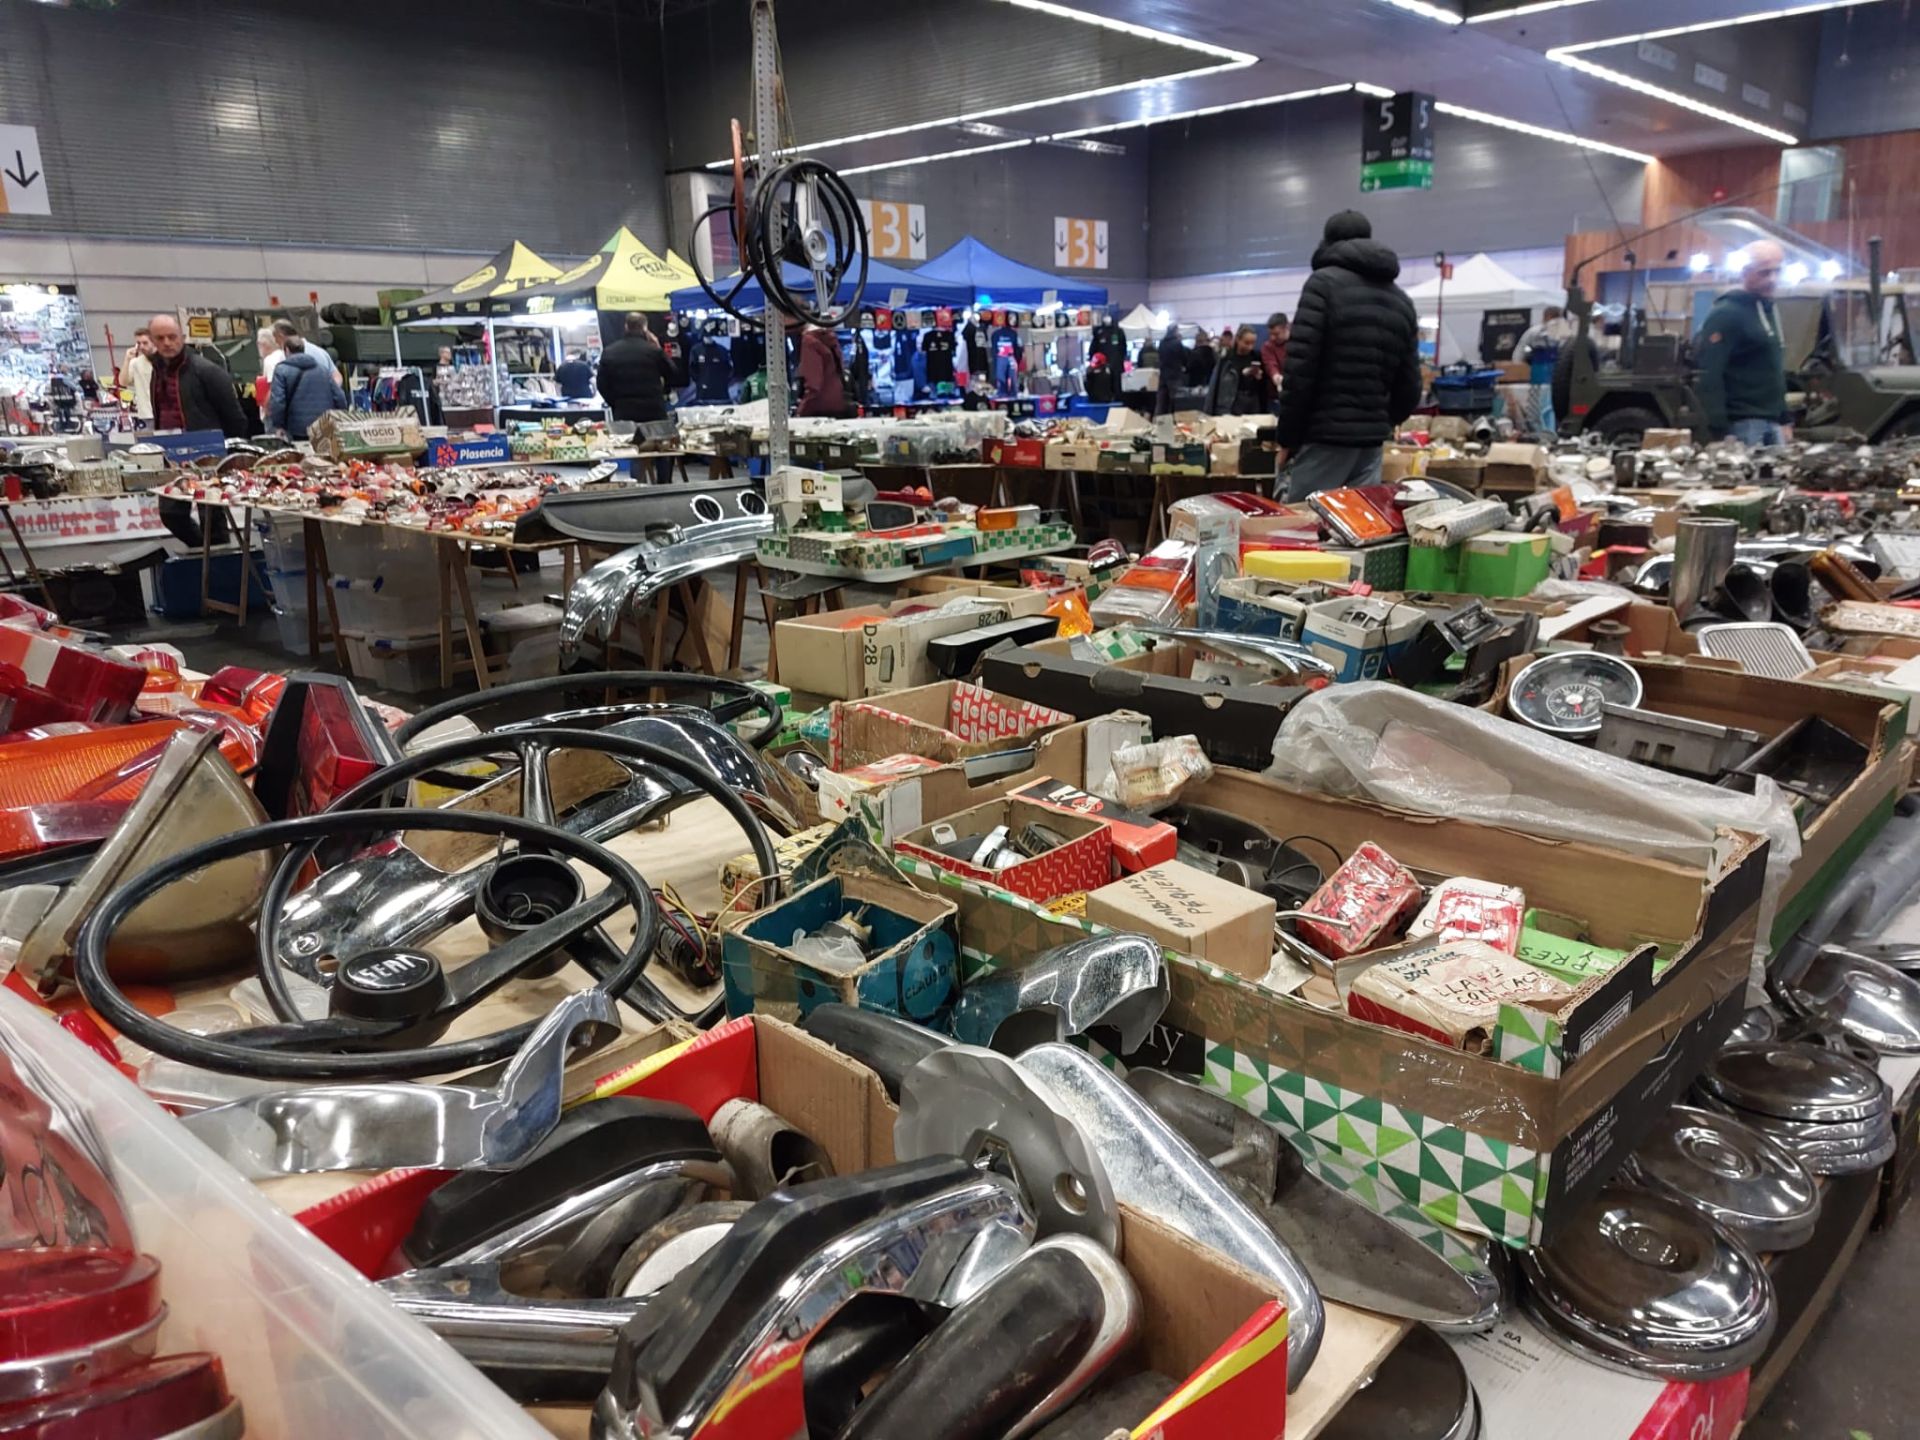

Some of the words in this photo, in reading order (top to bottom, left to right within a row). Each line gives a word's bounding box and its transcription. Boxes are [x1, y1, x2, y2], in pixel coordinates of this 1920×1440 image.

[1379, 101, 1394, 131] 5
[1419, 99, 1429, 129] 5
[881, 203, 900, 256] 3
[1073, 220, 1089, 266] 3
[459, 448, 504, 460] Plasencia
[864, 624, 878, 666] D-28
[1123, 879, 1196, 930] BOMBILLAS
